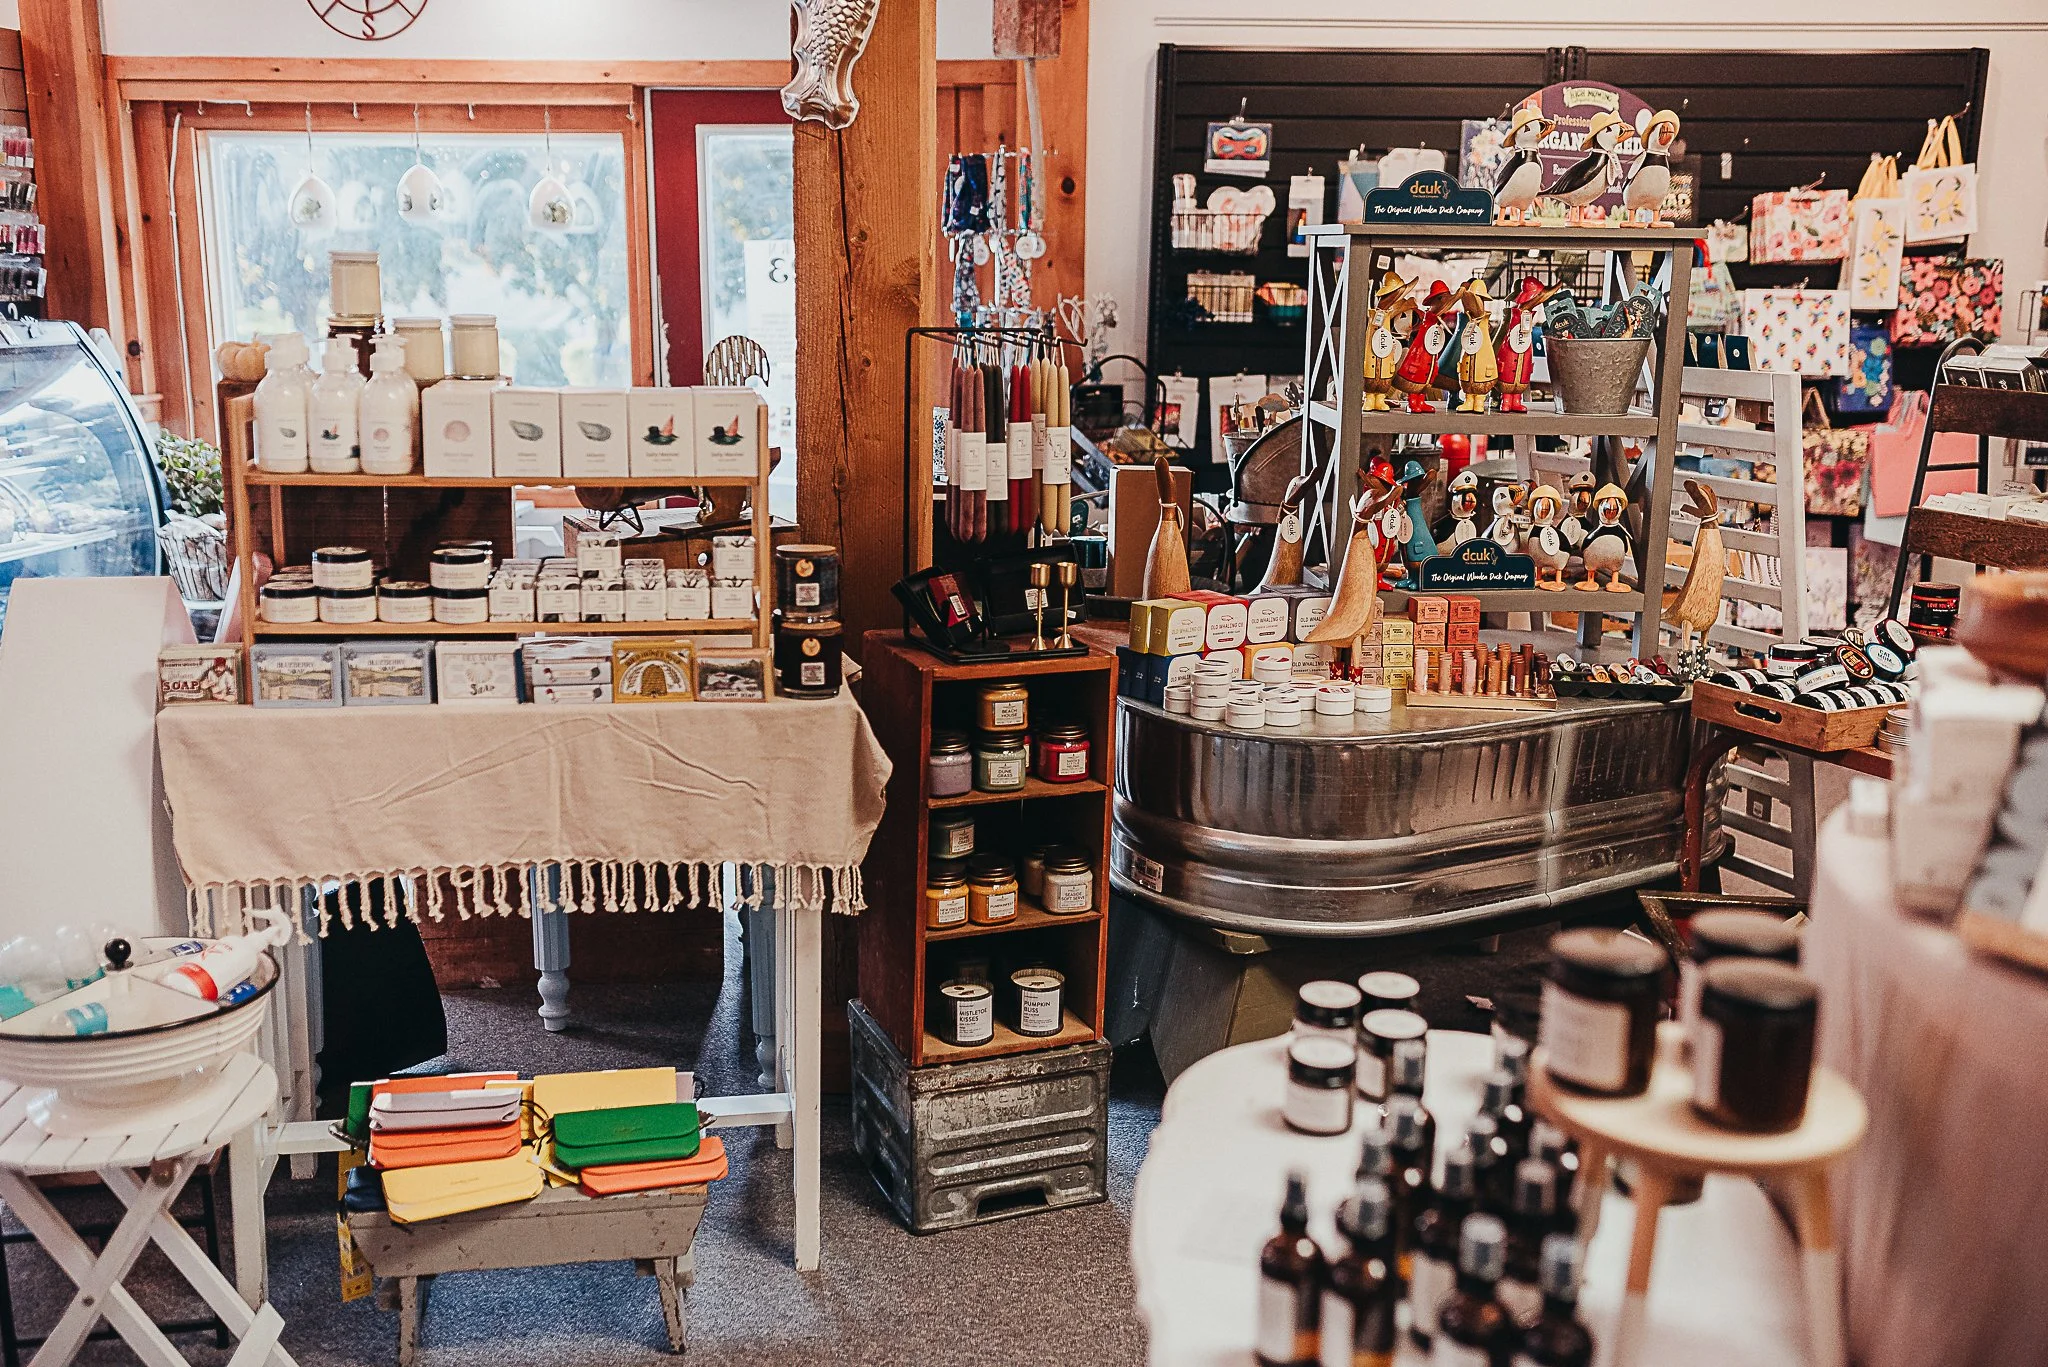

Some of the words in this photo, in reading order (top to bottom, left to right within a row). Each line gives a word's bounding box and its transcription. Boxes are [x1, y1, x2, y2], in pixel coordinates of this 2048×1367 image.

[1410, 180, 1441, 194] dcuk
[1374, 205, 1386, 213] The
[1387, 205, 1411, 215] Original
[1413, 204, 1437, 214] Wooden
[1439, 206, 1454, 214] Duck
[1456, 205, 1484, 217] Company
[1632, 300, 1646, 311] dcuk
[1554, 319, 1569, 329] dcuk
[1432, 330, 1440, 346] dcuk
[1462, 549, 1490, 561] dcuk
[1443, 573, 1465, 583] Original
[1467, 573, 1488, 581] Wooden
[1489, 573, 1503, 581] Duck
[1504, 572, 1528, 582] Company
[1877, 653, 1893, 663] MOM
[163, 681, 199, 691] SOAP
[960, 1008, 987, 1016] MISTLETOE
